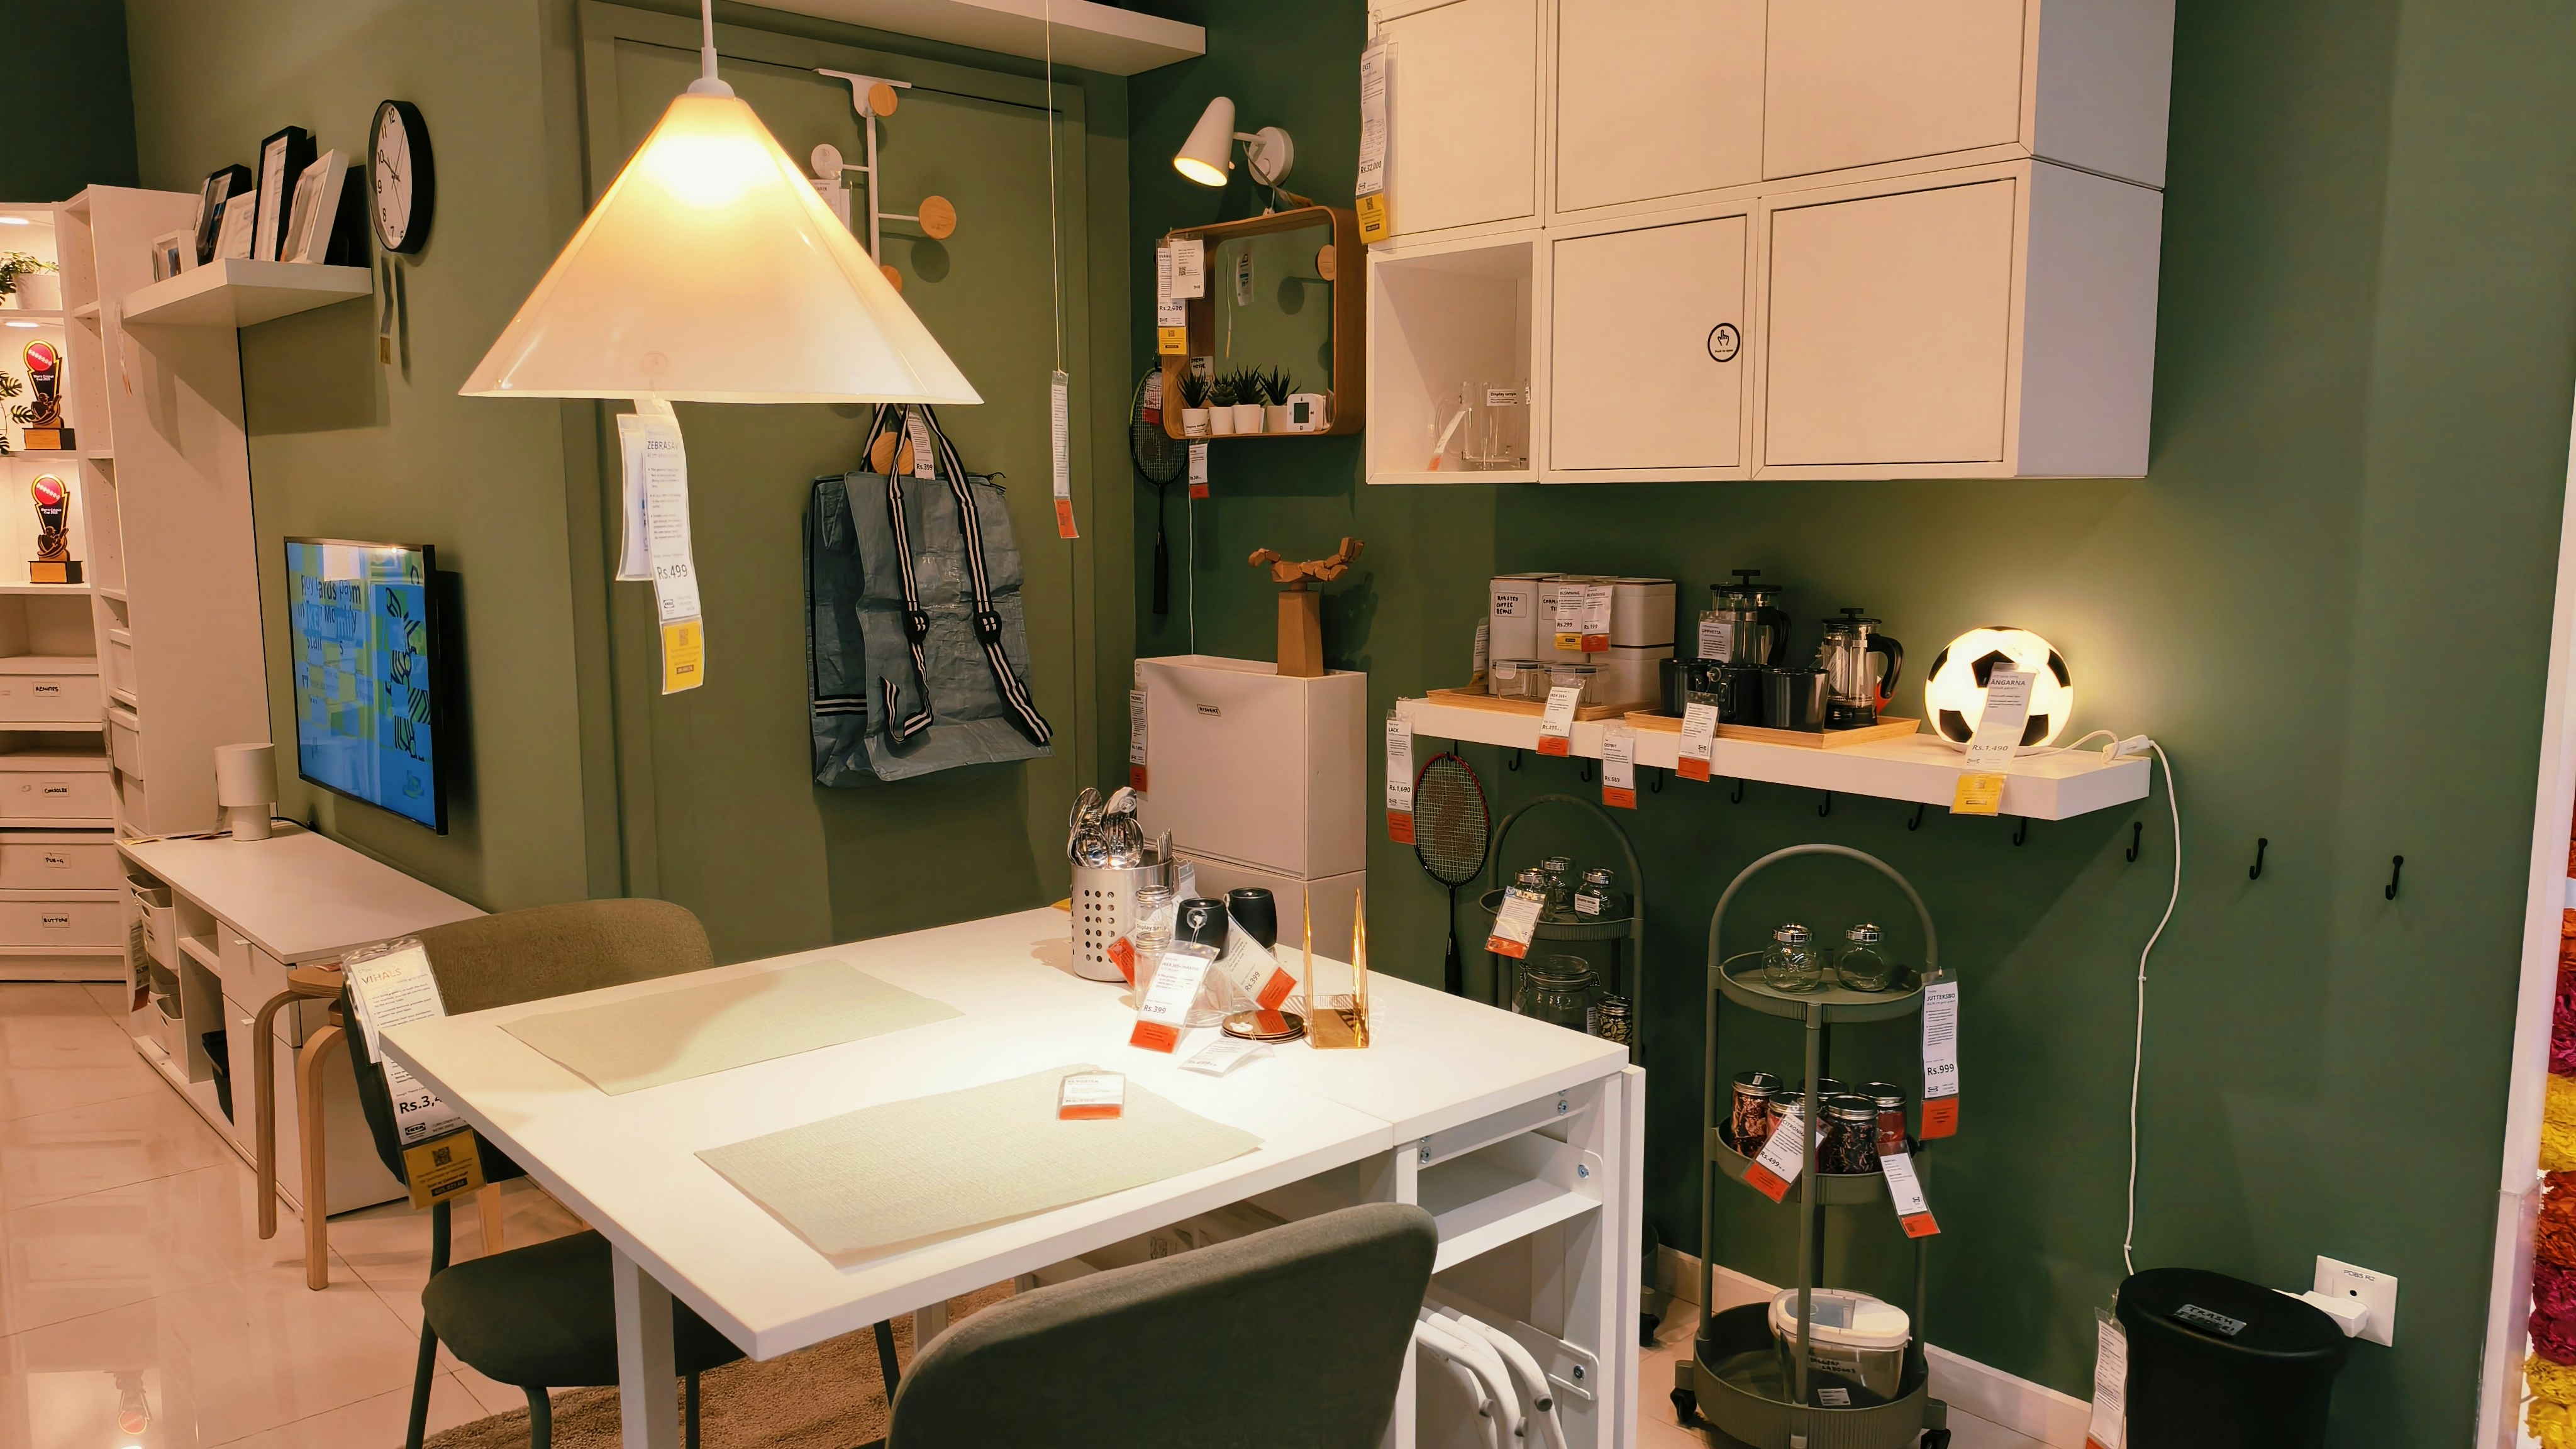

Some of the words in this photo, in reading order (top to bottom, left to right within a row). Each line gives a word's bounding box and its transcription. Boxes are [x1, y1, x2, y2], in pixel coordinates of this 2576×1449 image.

[1362, 62, 1370, 72] EKET
[388, 108, 396, 124] 12
[381, 125, 387, 140] 11
[377, 149, 385, 165] 10
[377, 179, 382, 194] 9
[382, 208, 387, 222] 8
[390, 226, 395, 240] 7
[657, 564, 688, 580] Rs.499
[361, 968, 402, 985] VIHALS
[1245, 970, 1260, 992] Rs.399
[1926, 993, 1955, 1001] JUTTERSBO
[1143, 1004, 1167, 1014] Rs.399
[1928, 1063, 1955, 1076] Rs.999
[1760, 1151, 1780, 1167] Rs.499
[2190, 1306, 2233, 1325] TRASH
